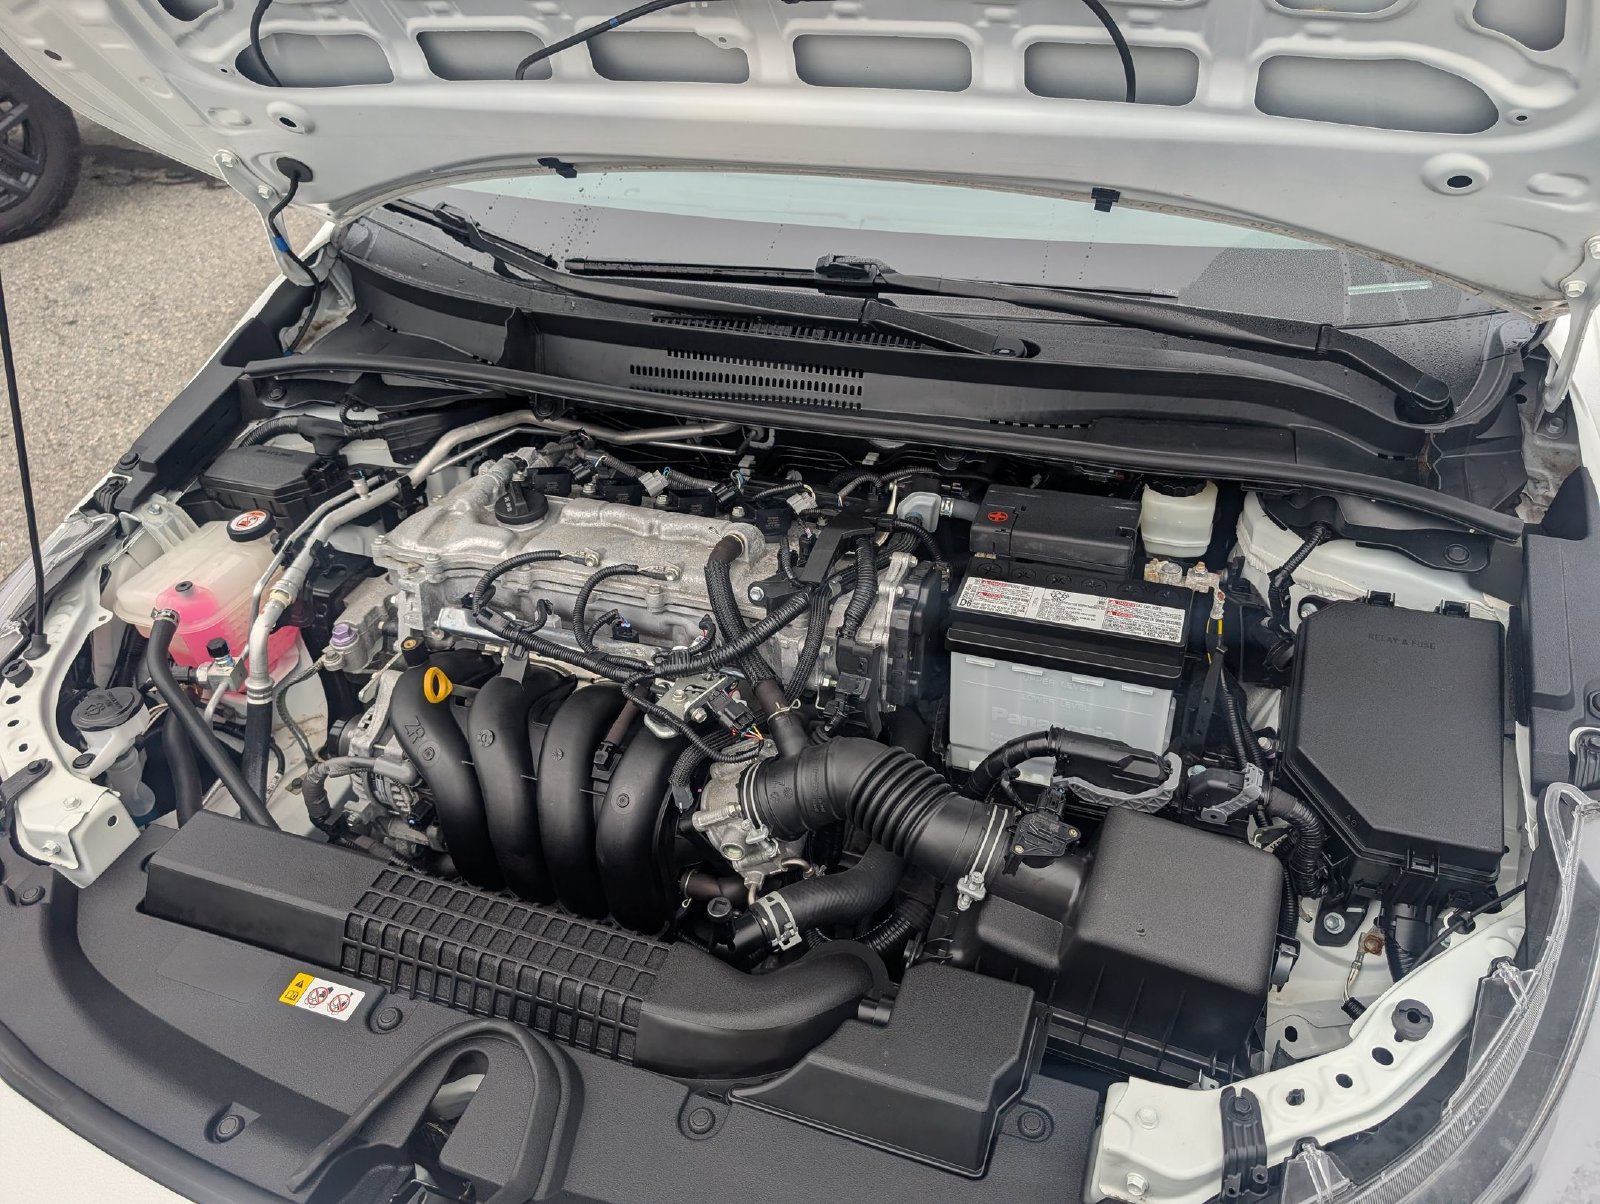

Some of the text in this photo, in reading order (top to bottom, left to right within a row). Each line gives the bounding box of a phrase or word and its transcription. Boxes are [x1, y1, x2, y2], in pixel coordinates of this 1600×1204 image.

[959, 598, 973, 607] D6
[1368, 633, 1398, 644] RELAY
[1411, 640, 1436, 650] FUSE
[1022, 675, 1055, 688] UPPER
[404, 715, 425, 744] ZR
